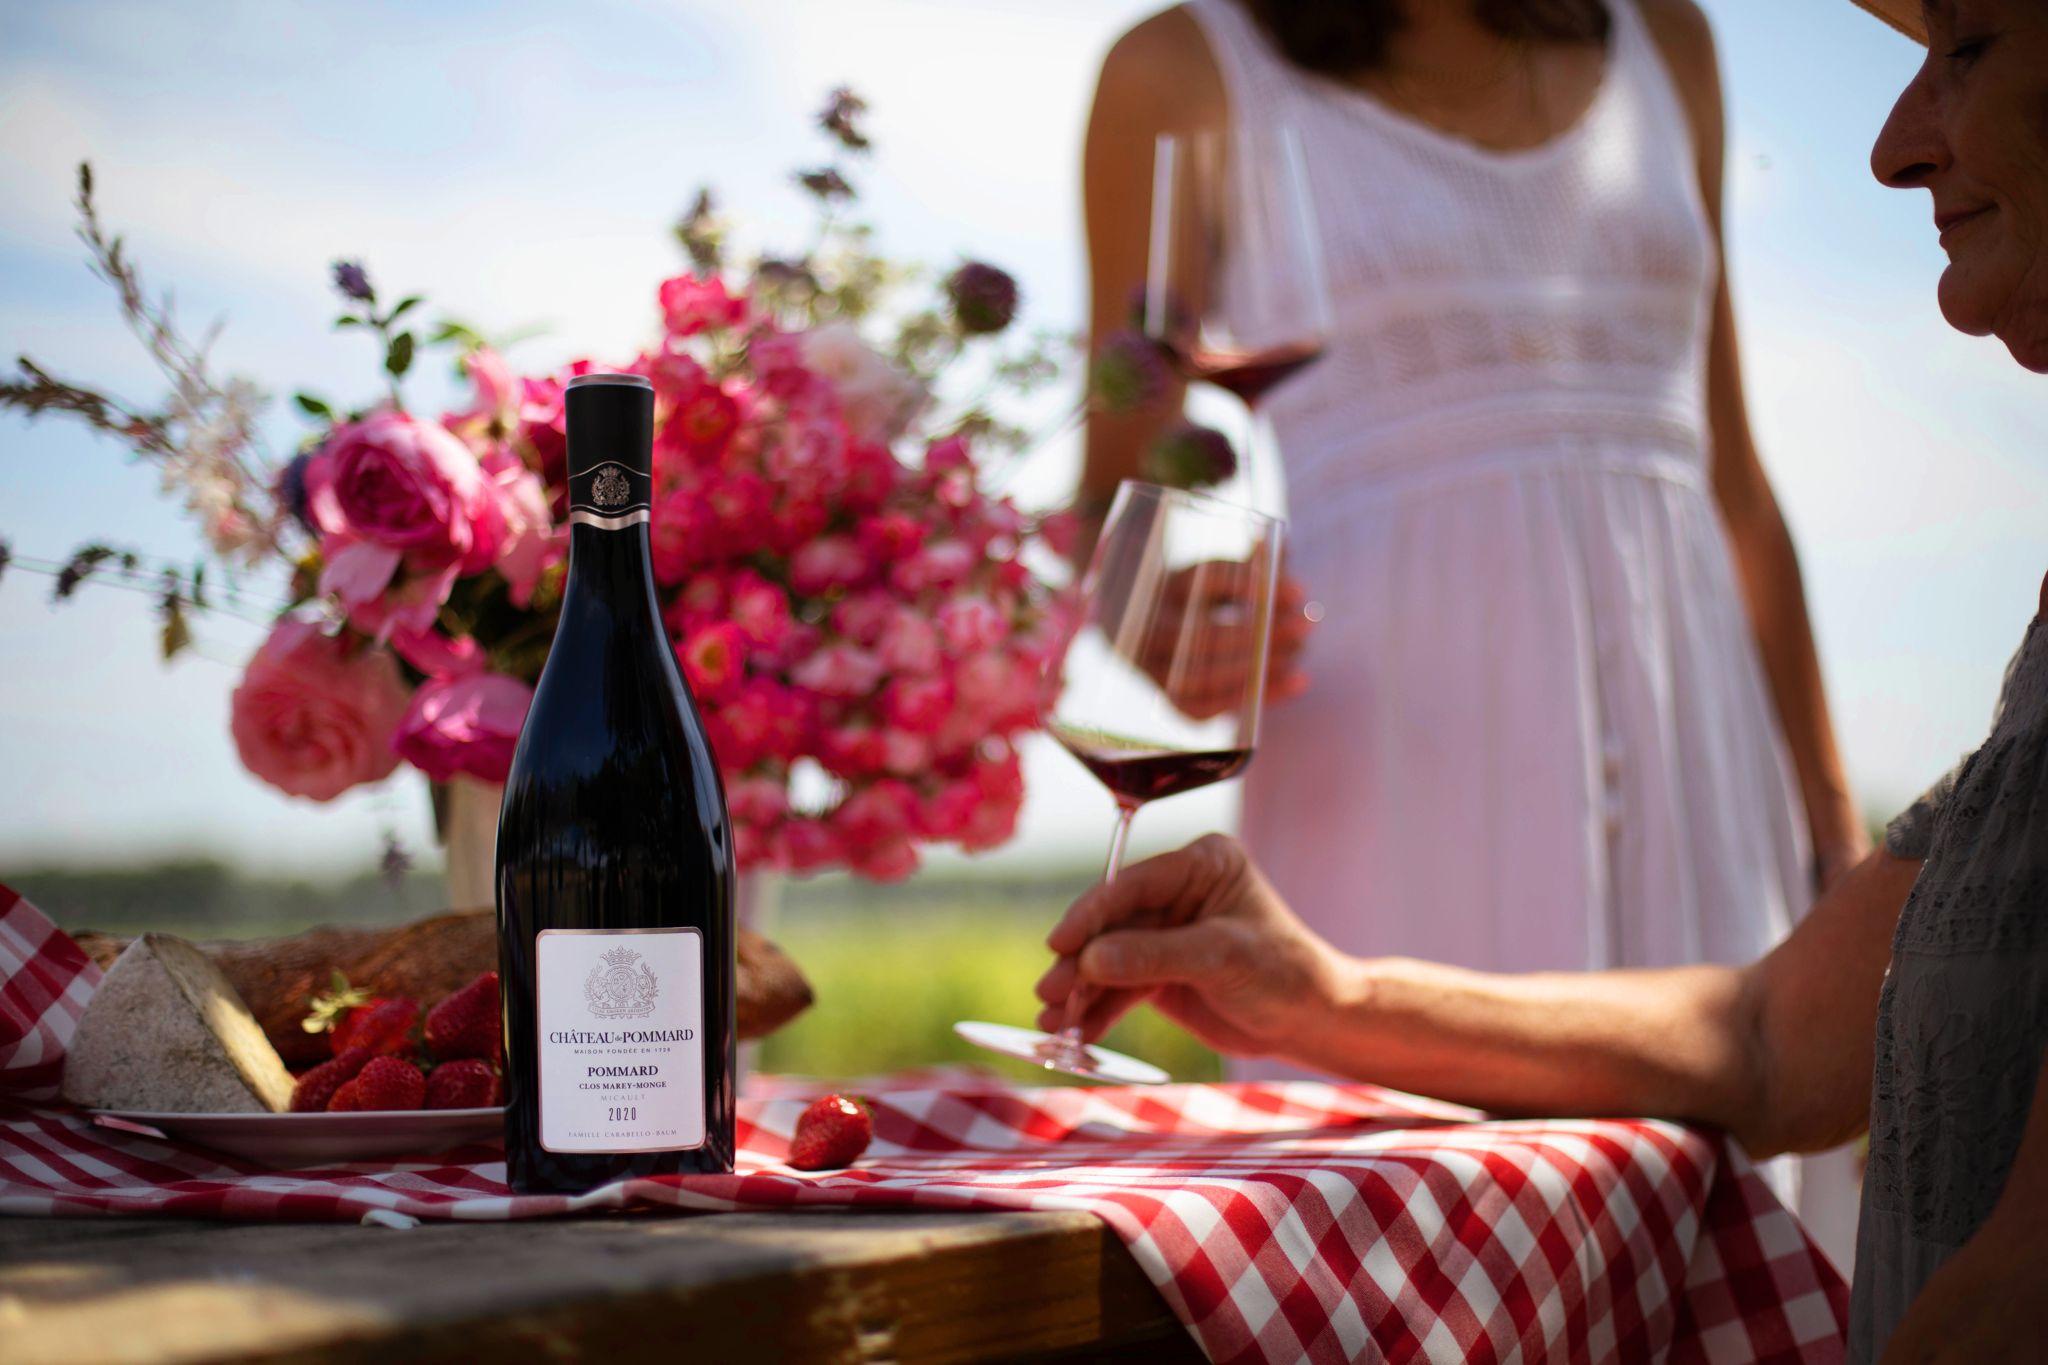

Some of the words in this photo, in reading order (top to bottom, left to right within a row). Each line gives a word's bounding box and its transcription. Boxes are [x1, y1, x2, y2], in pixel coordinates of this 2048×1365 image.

[550, 1029, 614, 1044] CHÂTEAU
[623, 1029, 694, 1043] POMMARD
[588, 1065, 659, 1077] POMMARD
[579, 1082, 600, 1090] CLOS
[602, 1081, 667, 1090] MAREY-MONGE
[609, 1107, 636, 1121] 2020
